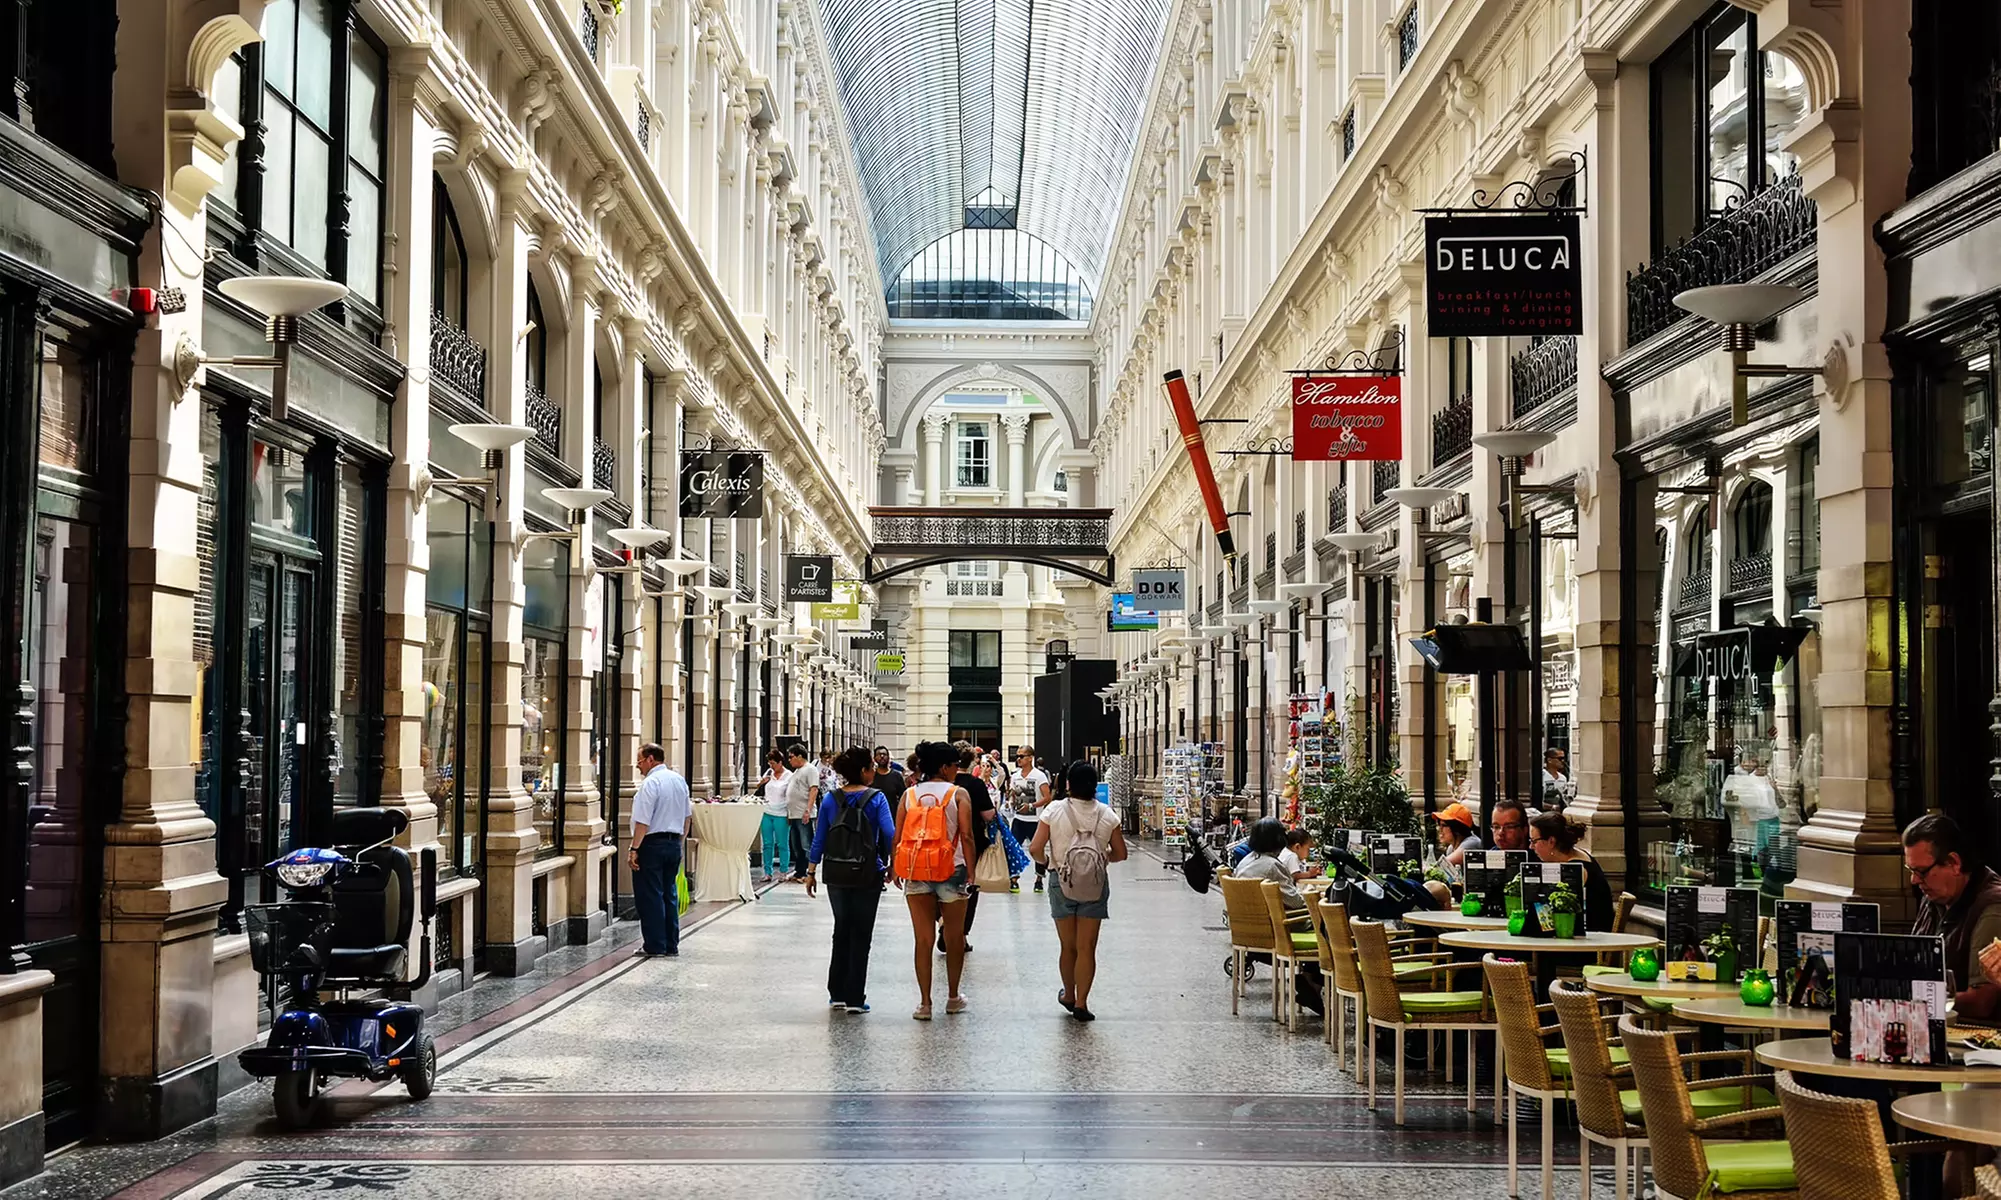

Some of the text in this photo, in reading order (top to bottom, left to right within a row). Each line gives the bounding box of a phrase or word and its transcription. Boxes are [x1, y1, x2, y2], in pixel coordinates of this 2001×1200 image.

[1437, 236, 1570, 271] DELUCA
[1437, 290, 1572, 300] breakfast/lunch
[1438, 303, 1572, 315] wining & dining
[1294, 382, 1399, 405] Hamilton
[1310, 409, 1385, 428] tobacco
[1339, 426, 1354, 443] &
[1328, 434, 1367, 457] gifts
[689, 470, 751, 495] Calexis
[1138, 582, 1180, 594] DOK
[1696, 629, 1752, 682] DELUCA
[1812, 909, 1842, 919] DELUCA
